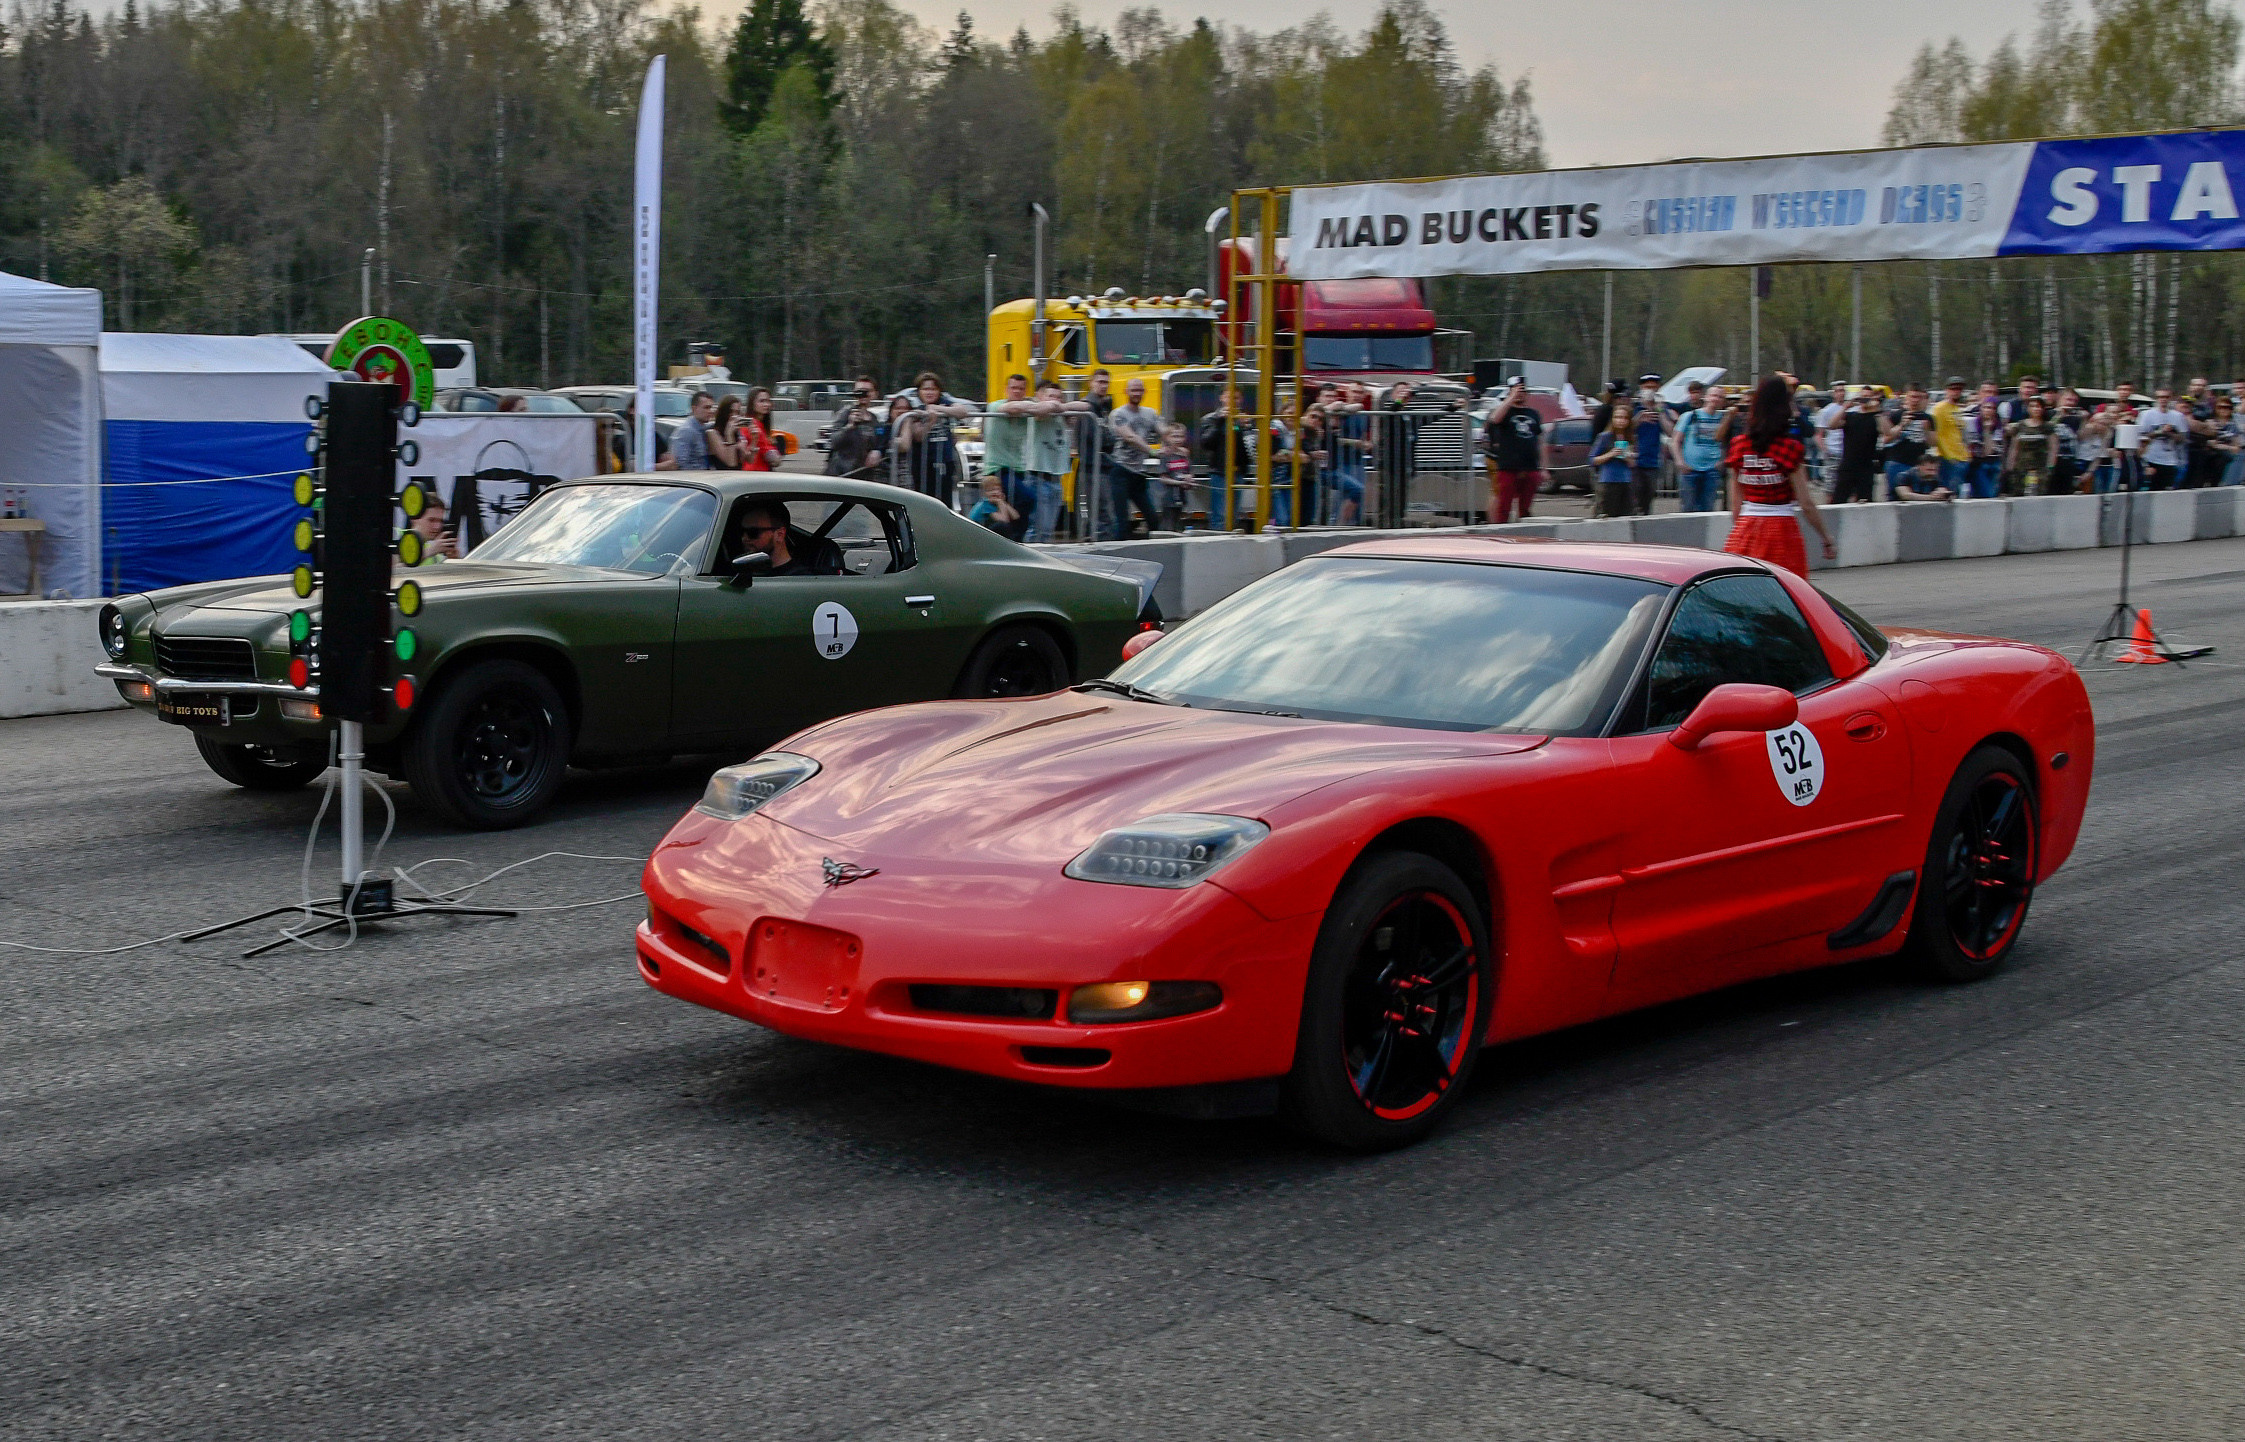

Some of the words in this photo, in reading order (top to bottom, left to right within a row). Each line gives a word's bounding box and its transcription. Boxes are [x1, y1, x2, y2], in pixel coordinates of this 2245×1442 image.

[2046, 161, 2240, 227] STA
[1314, 213, 1408, 249] MAD
[1420, 202, 1601, 244] BUCKETS
[826, 613, 838, 638] 7
[176, 706, 191, 715] BIG
[193, 707, 218, 716] TOYS
[1774, 730, 1812, 774] 52
